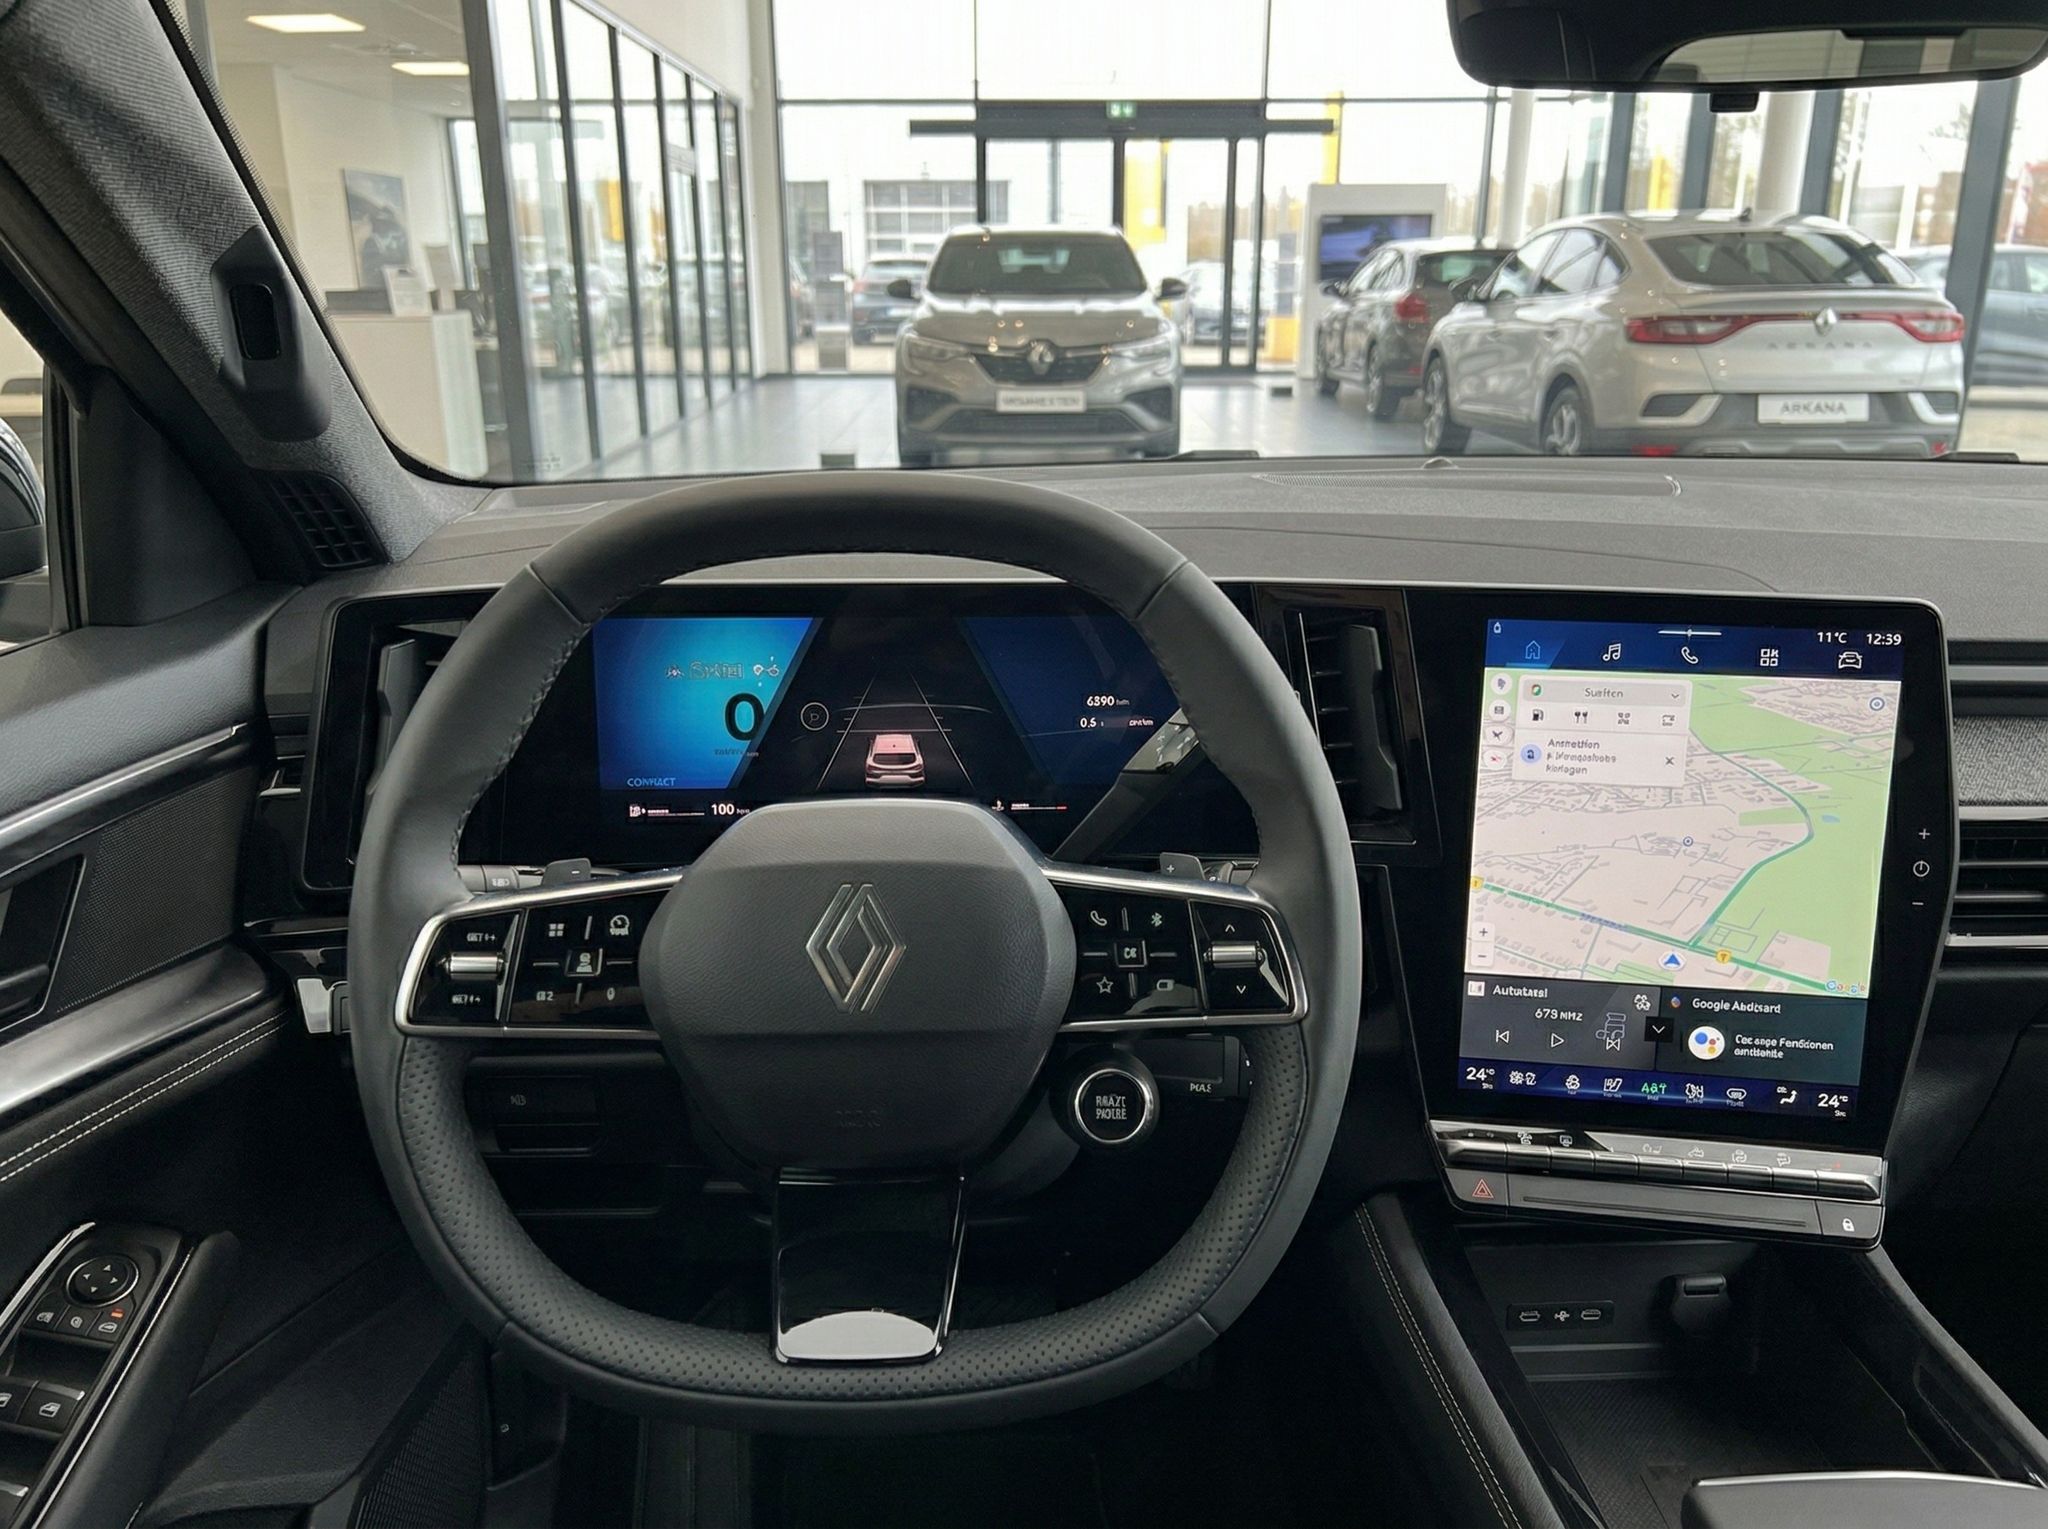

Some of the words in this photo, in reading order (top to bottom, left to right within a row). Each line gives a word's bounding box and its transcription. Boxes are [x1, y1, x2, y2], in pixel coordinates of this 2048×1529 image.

[1780, 401, 1848, 416] ARKANA
[1817, 631, 1847, 644] 11°C
[1866, 633, 1902, 646] 12:39
[724, 693, 765, 741] 0
[711, 803, 735, 816] 100
[1692, 998, 1731, 1013] Google
